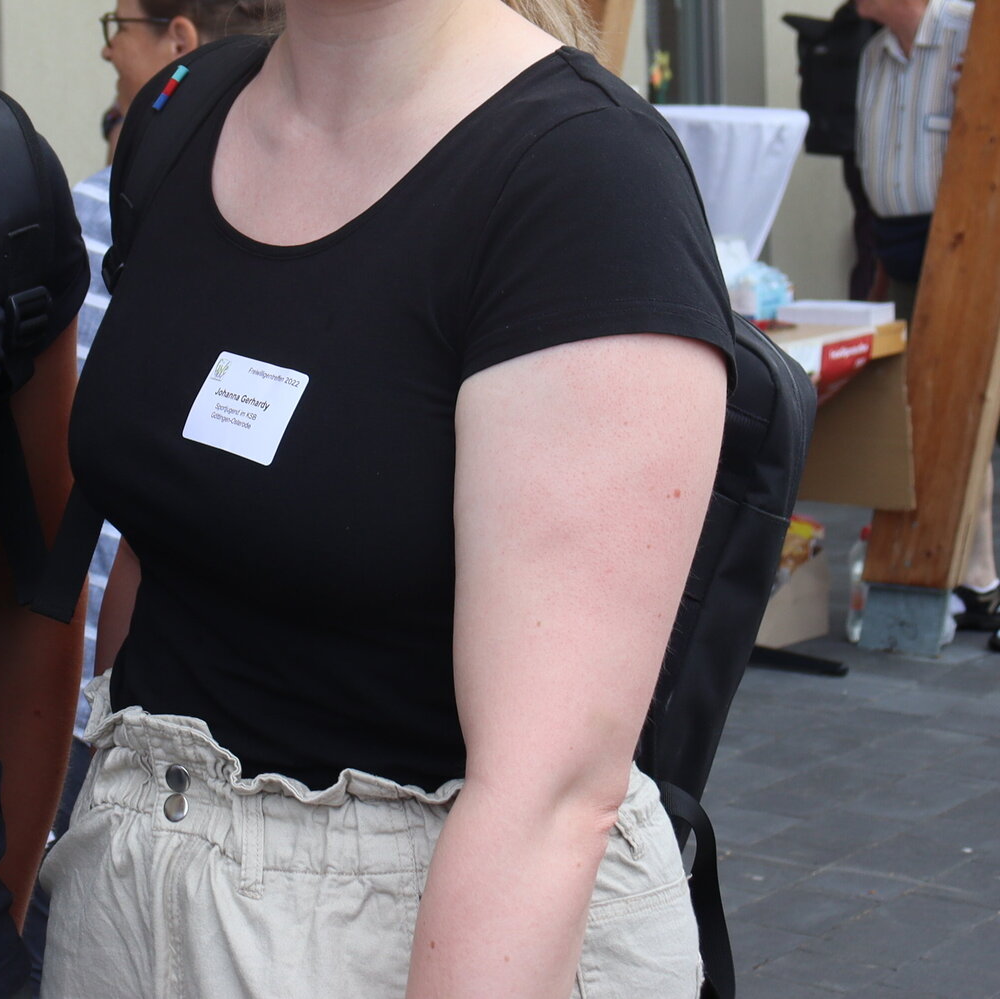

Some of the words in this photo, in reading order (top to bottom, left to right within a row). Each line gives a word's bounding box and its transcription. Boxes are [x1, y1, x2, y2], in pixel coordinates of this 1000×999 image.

[284, 377, 300, 388] 2022
[215, 387, 240, 401] Johanna
[240, 394, 271, 412] Gerhardy
[246, 412, 257, 421] KSB
